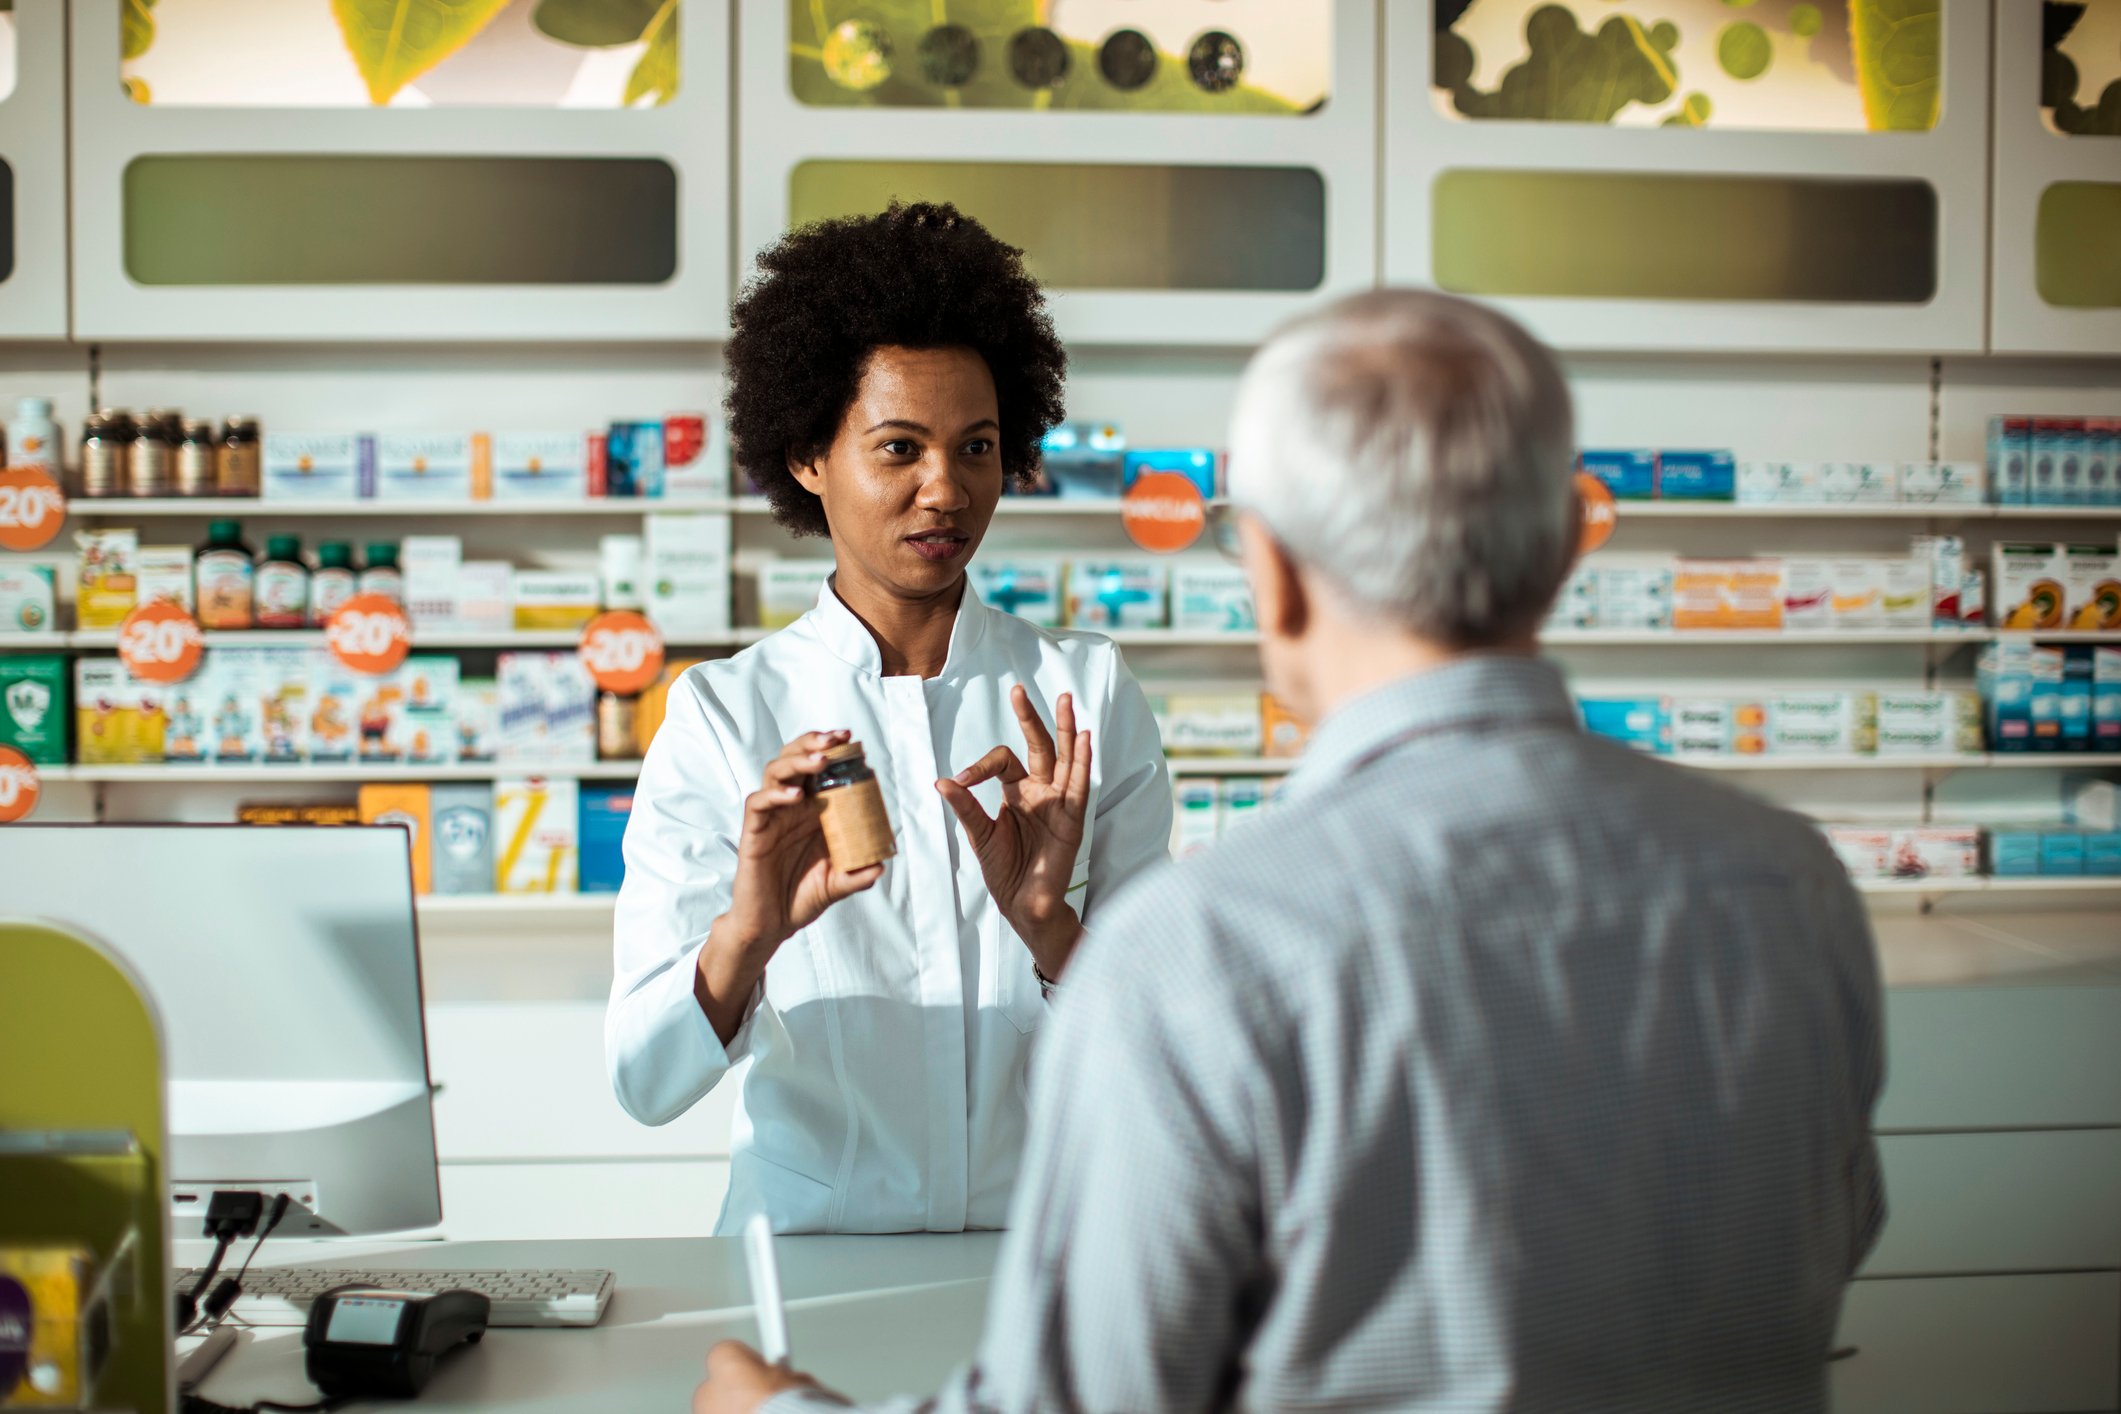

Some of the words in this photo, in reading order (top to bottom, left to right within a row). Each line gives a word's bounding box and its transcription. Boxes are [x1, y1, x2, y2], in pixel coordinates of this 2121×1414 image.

[0, 485, 63, 527] 20%
[123, 619, 203, 663] -20%
[330, 610, 408, 656] -20%
[583, 628, 664, 672] -20%
